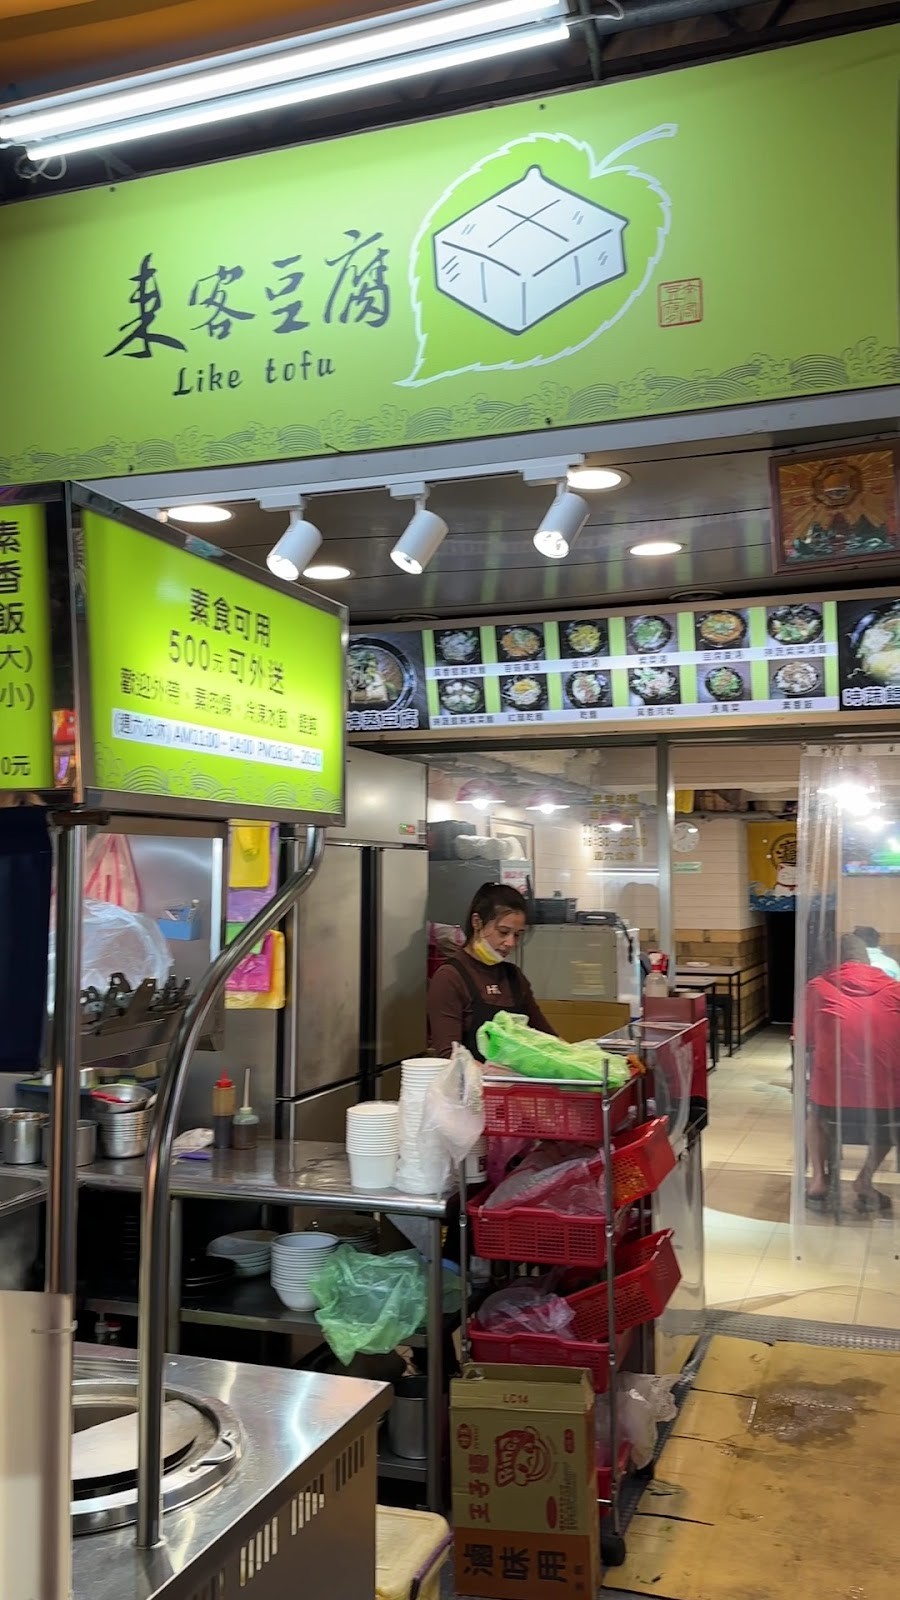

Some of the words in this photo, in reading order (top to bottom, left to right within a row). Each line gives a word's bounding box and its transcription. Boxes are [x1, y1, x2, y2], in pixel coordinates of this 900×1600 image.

[172, 361, 243, 397] Like
[264, 349, 336, 386] tofu
[189, 587, 272, 649] 素食可用
[169, 629, 285, 696] 500元可外送
